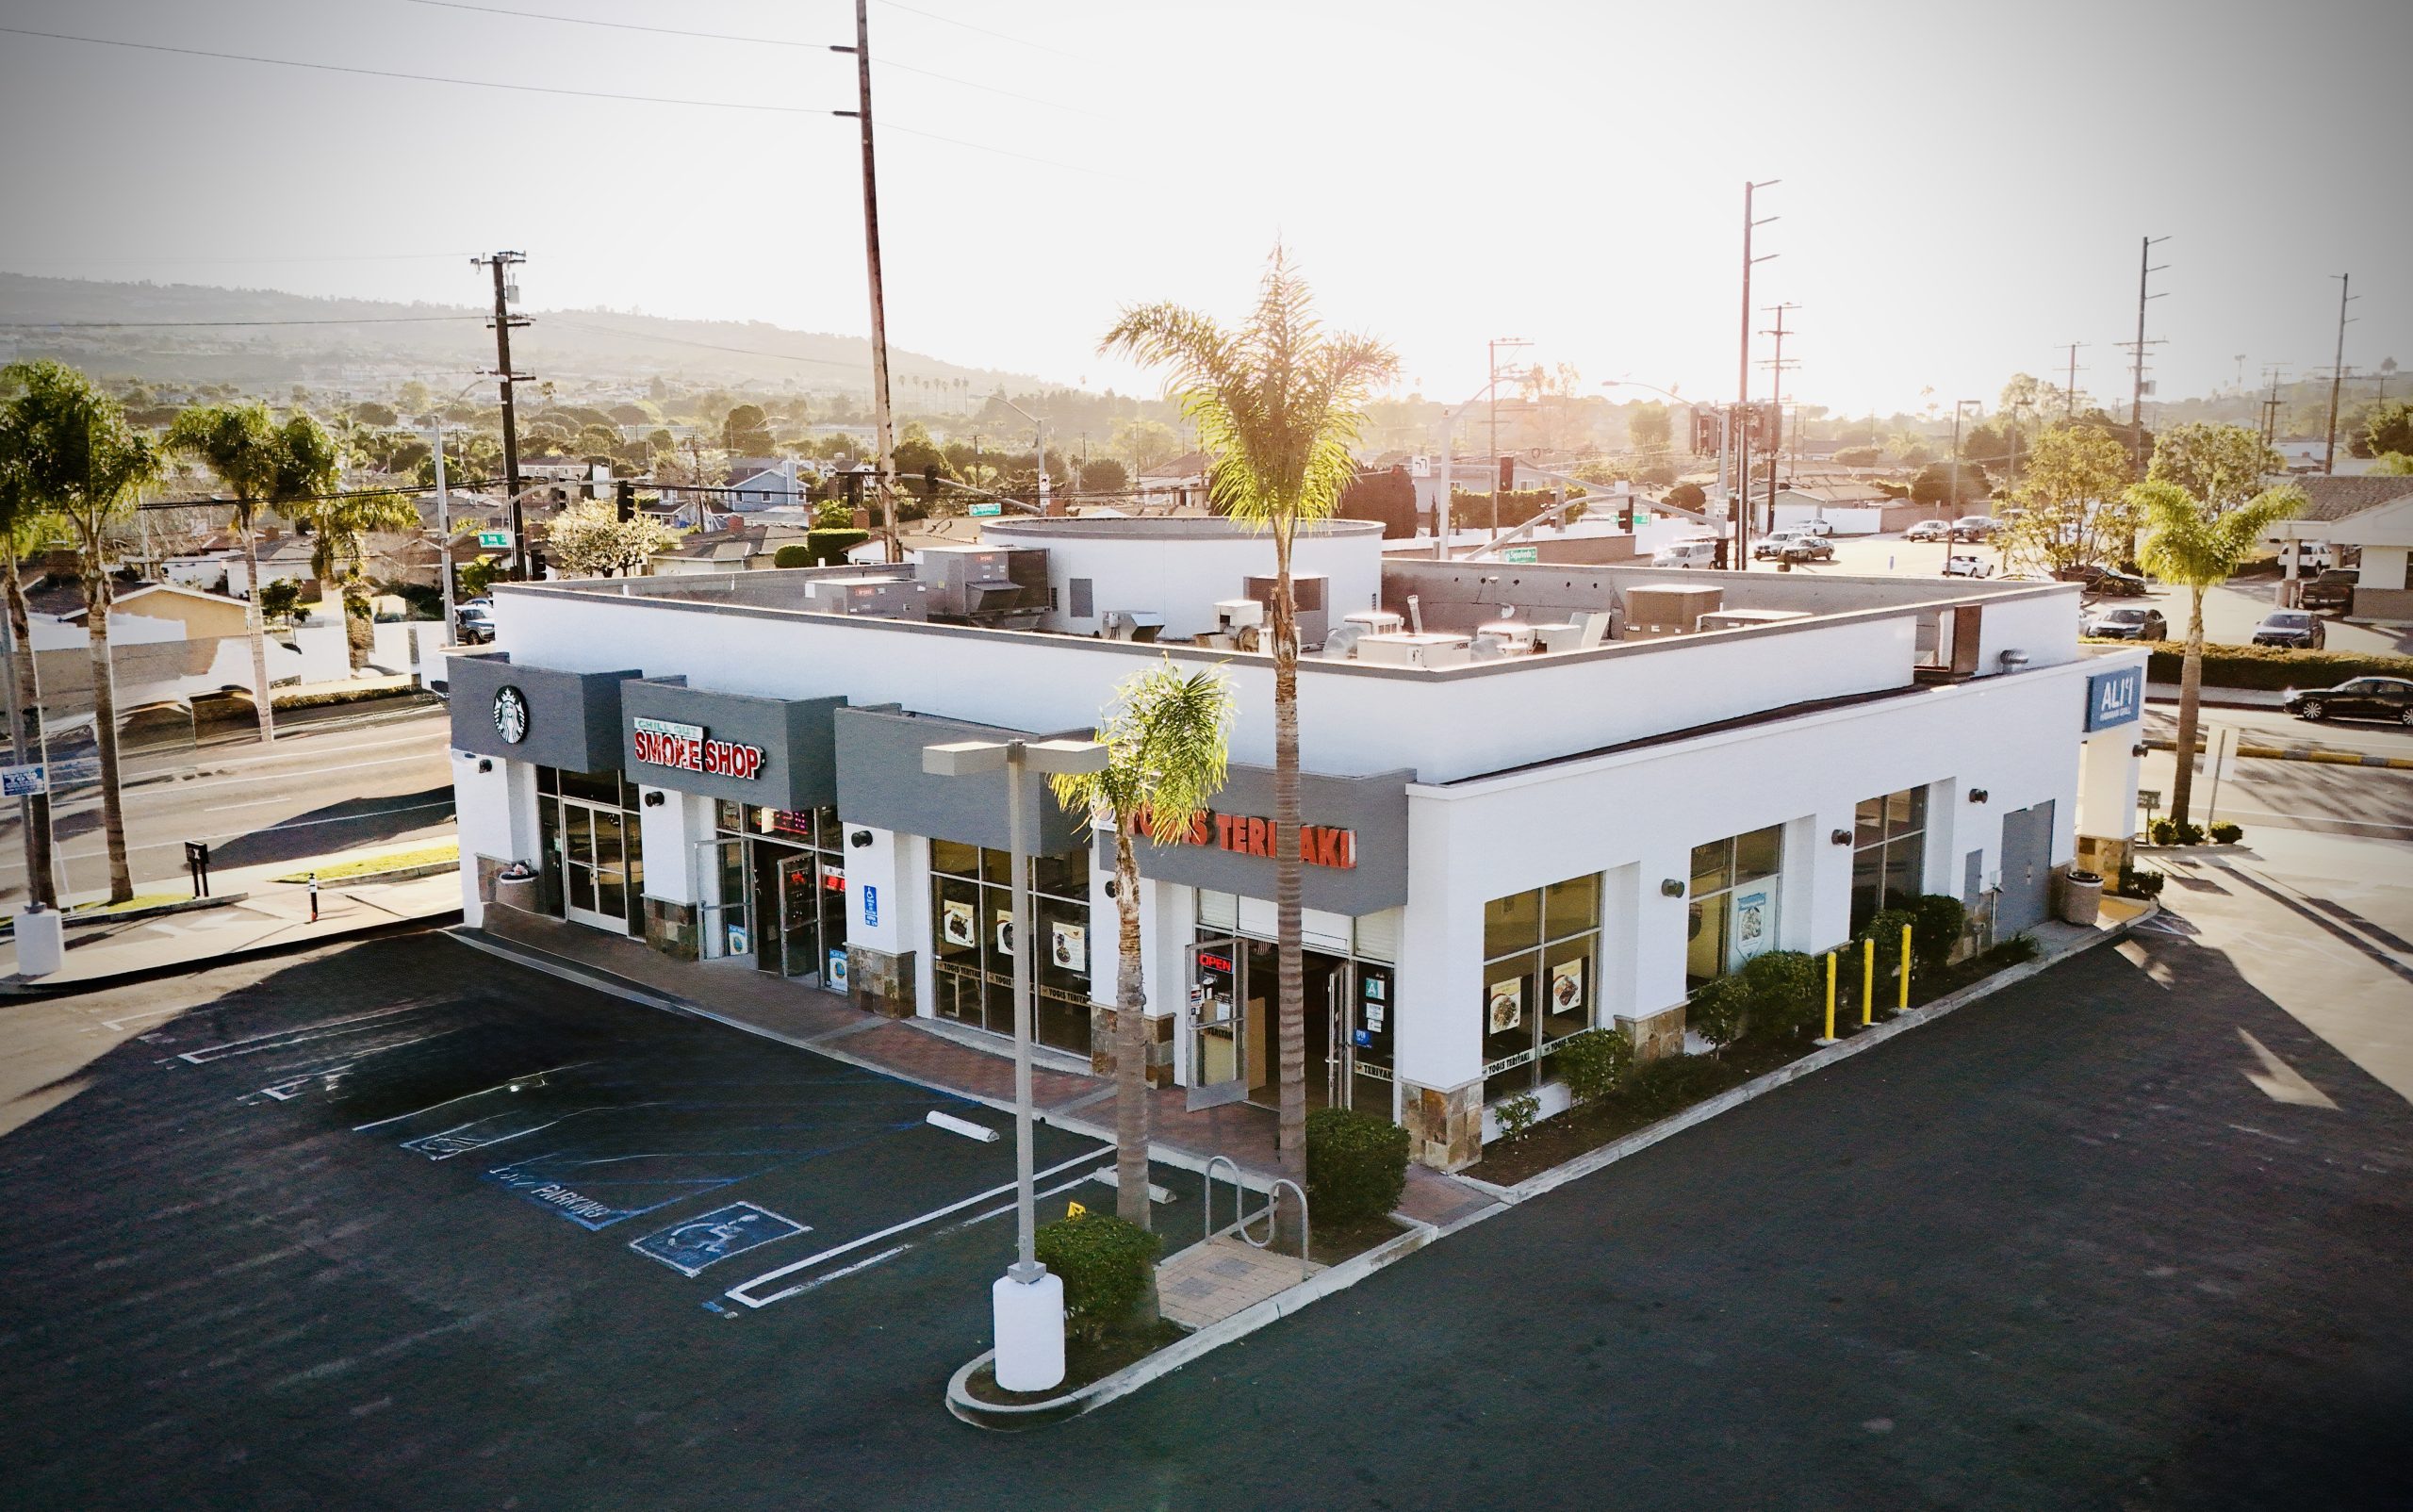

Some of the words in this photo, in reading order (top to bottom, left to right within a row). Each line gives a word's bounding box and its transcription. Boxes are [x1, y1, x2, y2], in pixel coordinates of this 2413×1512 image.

[637, 719, 670, 731] CHILL
[634, 729, 703, 772] SMOKE
[704, 739, 762, 781] SHOP
[1215, 813, 1357, 869] TERIAKI
[1199, 953, 1231, 972] OPEN
[1368, 982, 1376, 995] A
[1506, 1052, 1530, 1068] TERIYAKI
[530, 1183, 613, 1219] PARKING
